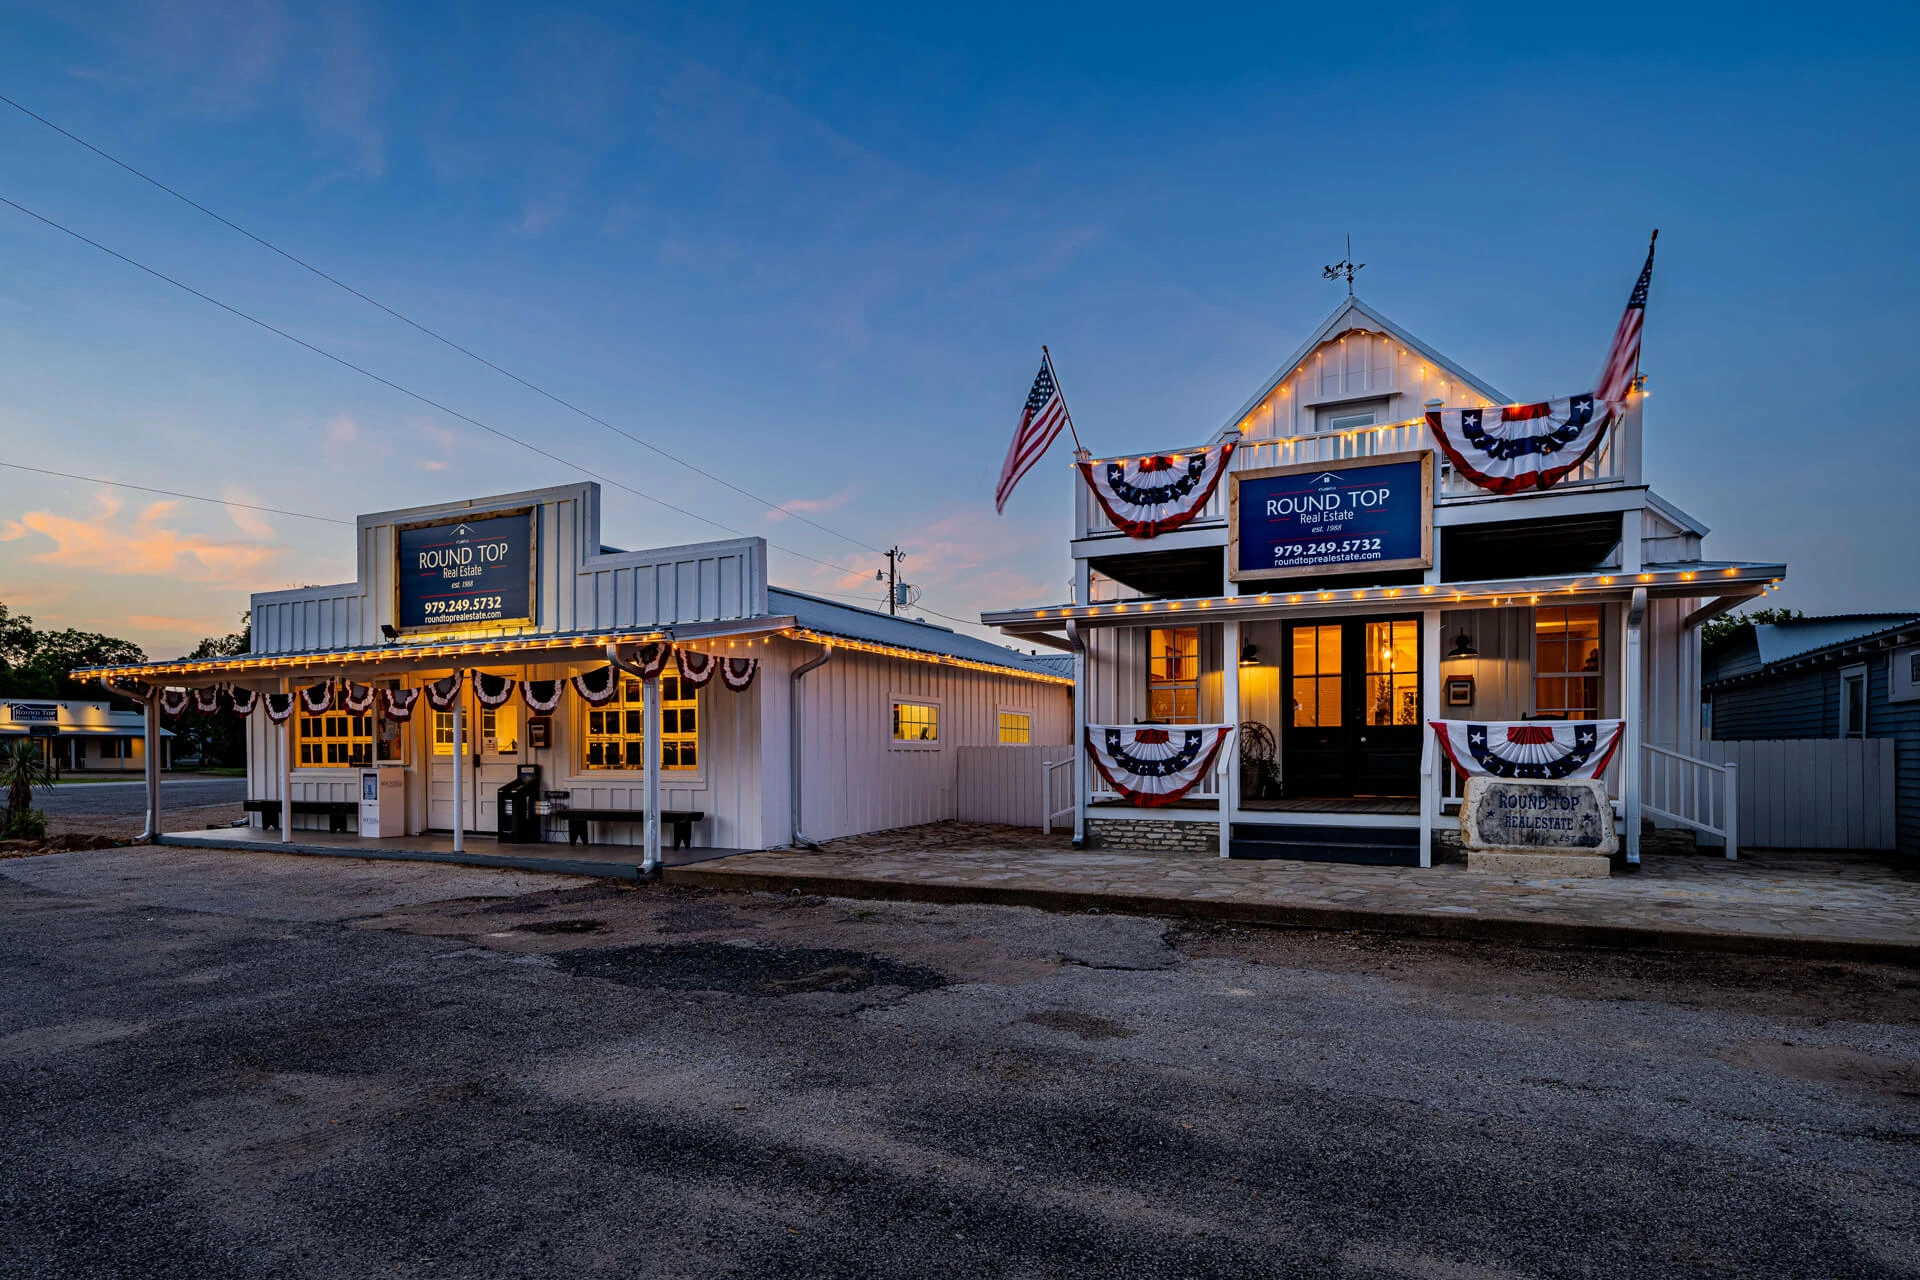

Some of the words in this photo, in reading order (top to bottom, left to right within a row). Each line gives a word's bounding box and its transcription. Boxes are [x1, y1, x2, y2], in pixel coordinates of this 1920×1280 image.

[1267, 493, 1340, 516] ROUND
[1348, 488, 1390, 508] TOP
[1300, 512, 1321, 524] Real
[1323, 509, 1354, 522] Estate
[1311, 525, 1324, 533] est.
[1326, 524, 1342, 532] 1988
[419, 547, 473, 569] ROUND
[477, 543, 508, 562] TOP
[1274, 538, 1381, 558] 979.249.5732
[1274, 551, 1381, 567] roundtoprealestate.com
[443, 567, 458, 579] Real
[460, 565, 482, 577] Estate
[425, 596, 502, 614] 979.249.5732
[425, 611, 502, 624] roundtoprealestate.com
[1499, 795, 1548, 810] ROUND
[1552, 795, 1579, 811] TOP
[1505, 815, 1533, 828] REAL
[1535, 816, 1573, 830] ESTATE
